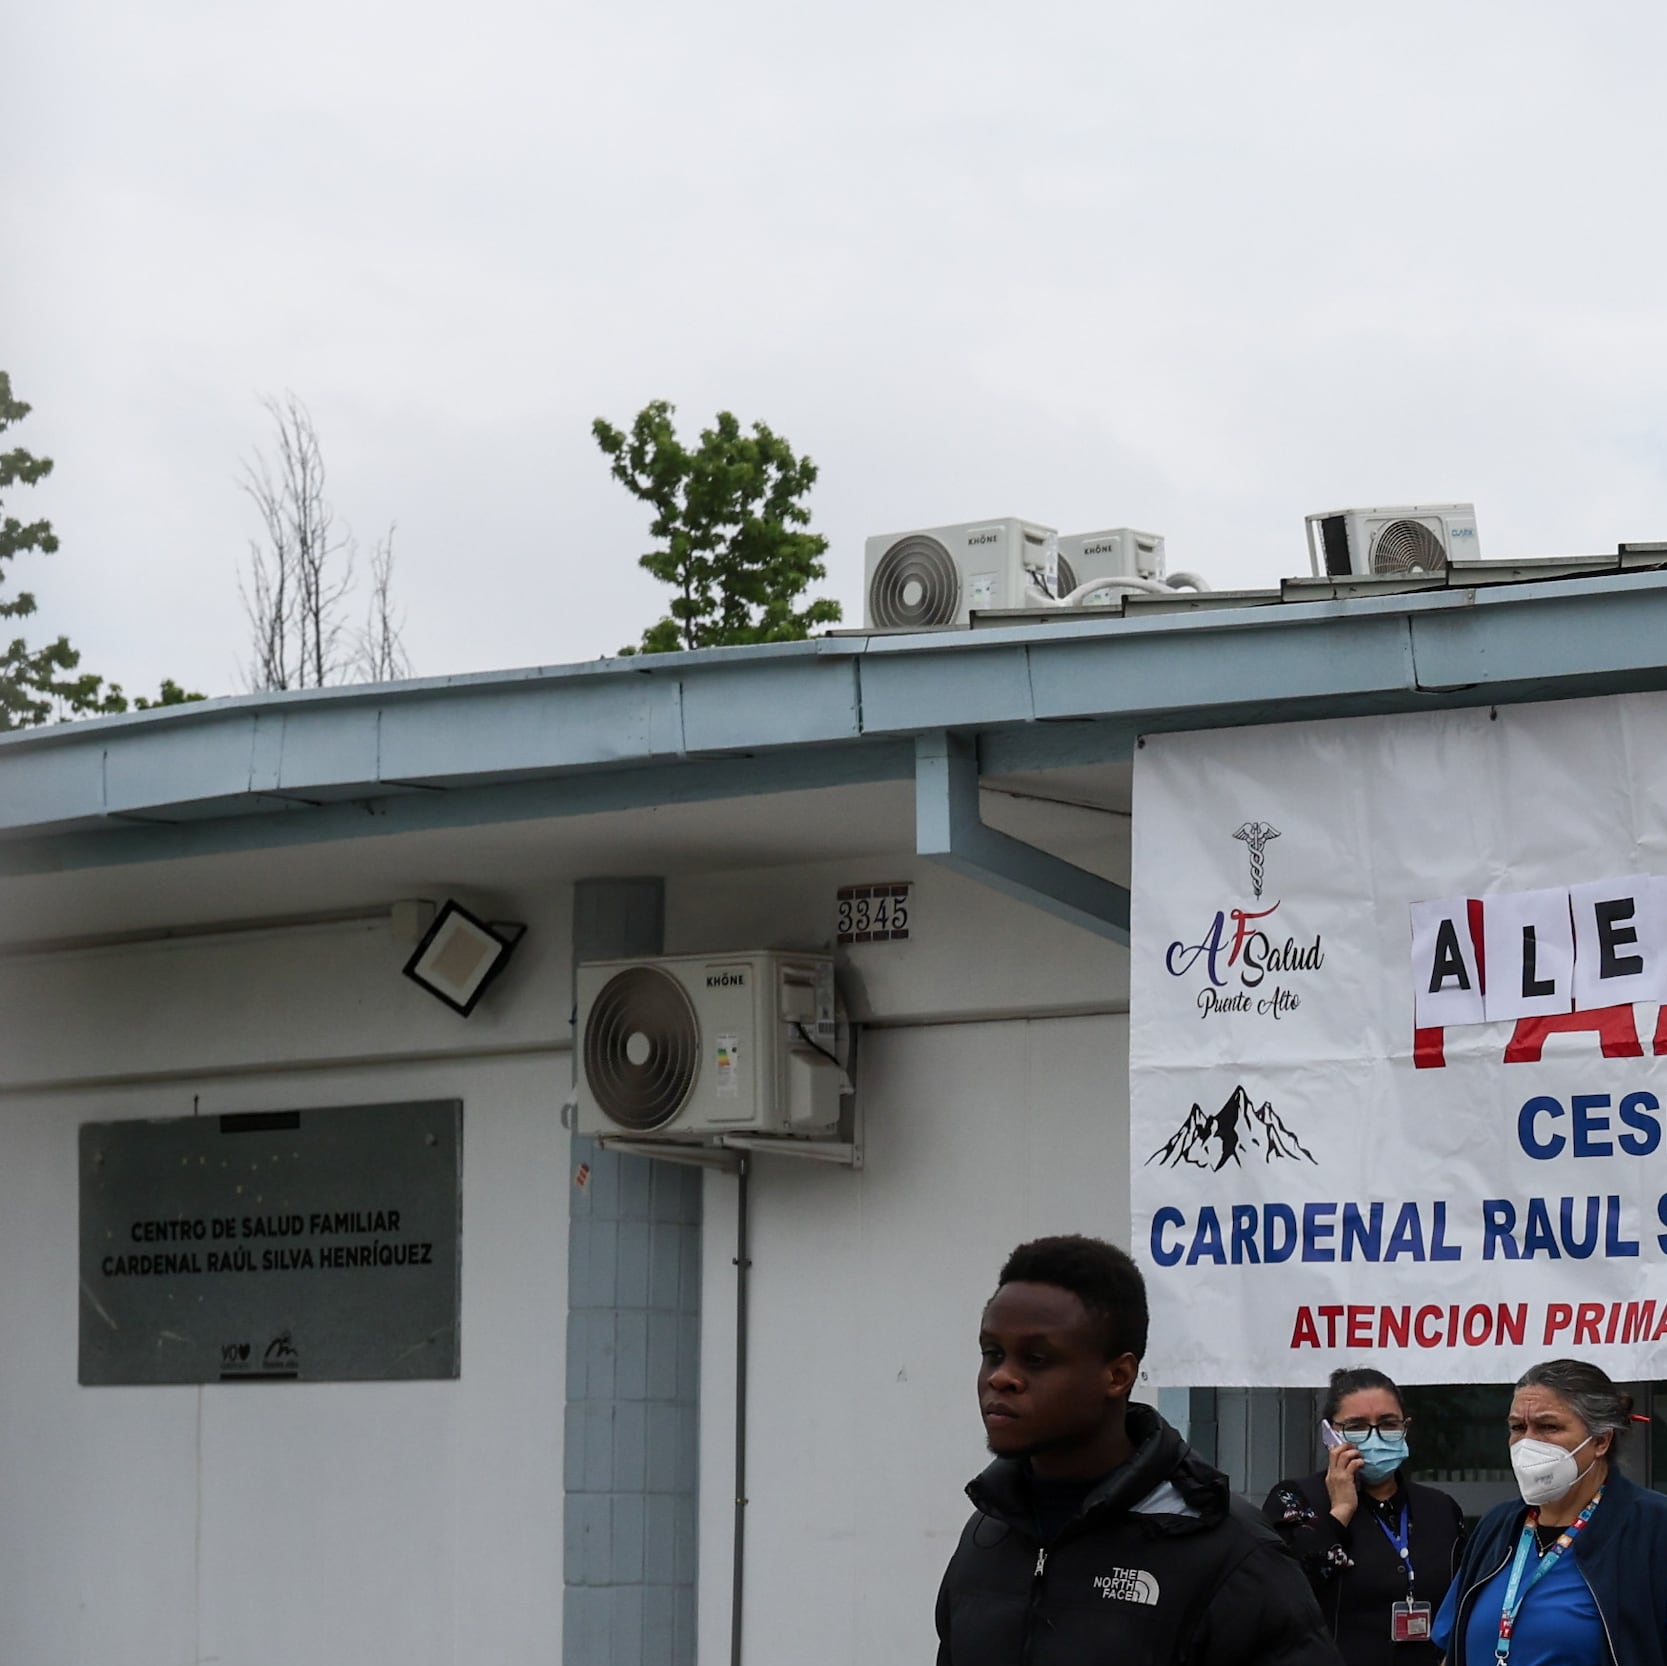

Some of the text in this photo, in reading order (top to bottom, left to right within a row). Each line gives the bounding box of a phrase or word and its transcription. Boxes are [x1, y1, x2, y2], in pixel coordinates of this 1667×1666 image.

[838, 897, 908, 933] 3345
[1240, 931, 1325, 988] Salud
[1197, 986, 1302, 1020] Puente Alto
[131, 1210, 401, 1242] CENTRO DE SALUD FAMILIAR
[1150, 1201, 1462, 1267] CARDENAL
[1482, 1195, 1640, 1260] RAUL
[102, 1240, 433, 1277] CARDENAL RAÚL SILVA HENRÍQUEZ
[1290, 1303, 1528, 1349] ATENCION
[1093, 1576, 1135, 1592] NORTH
[1112, 1567, 1137, 1580] THE
[1102, 1588, 1133, 1601] FACE
